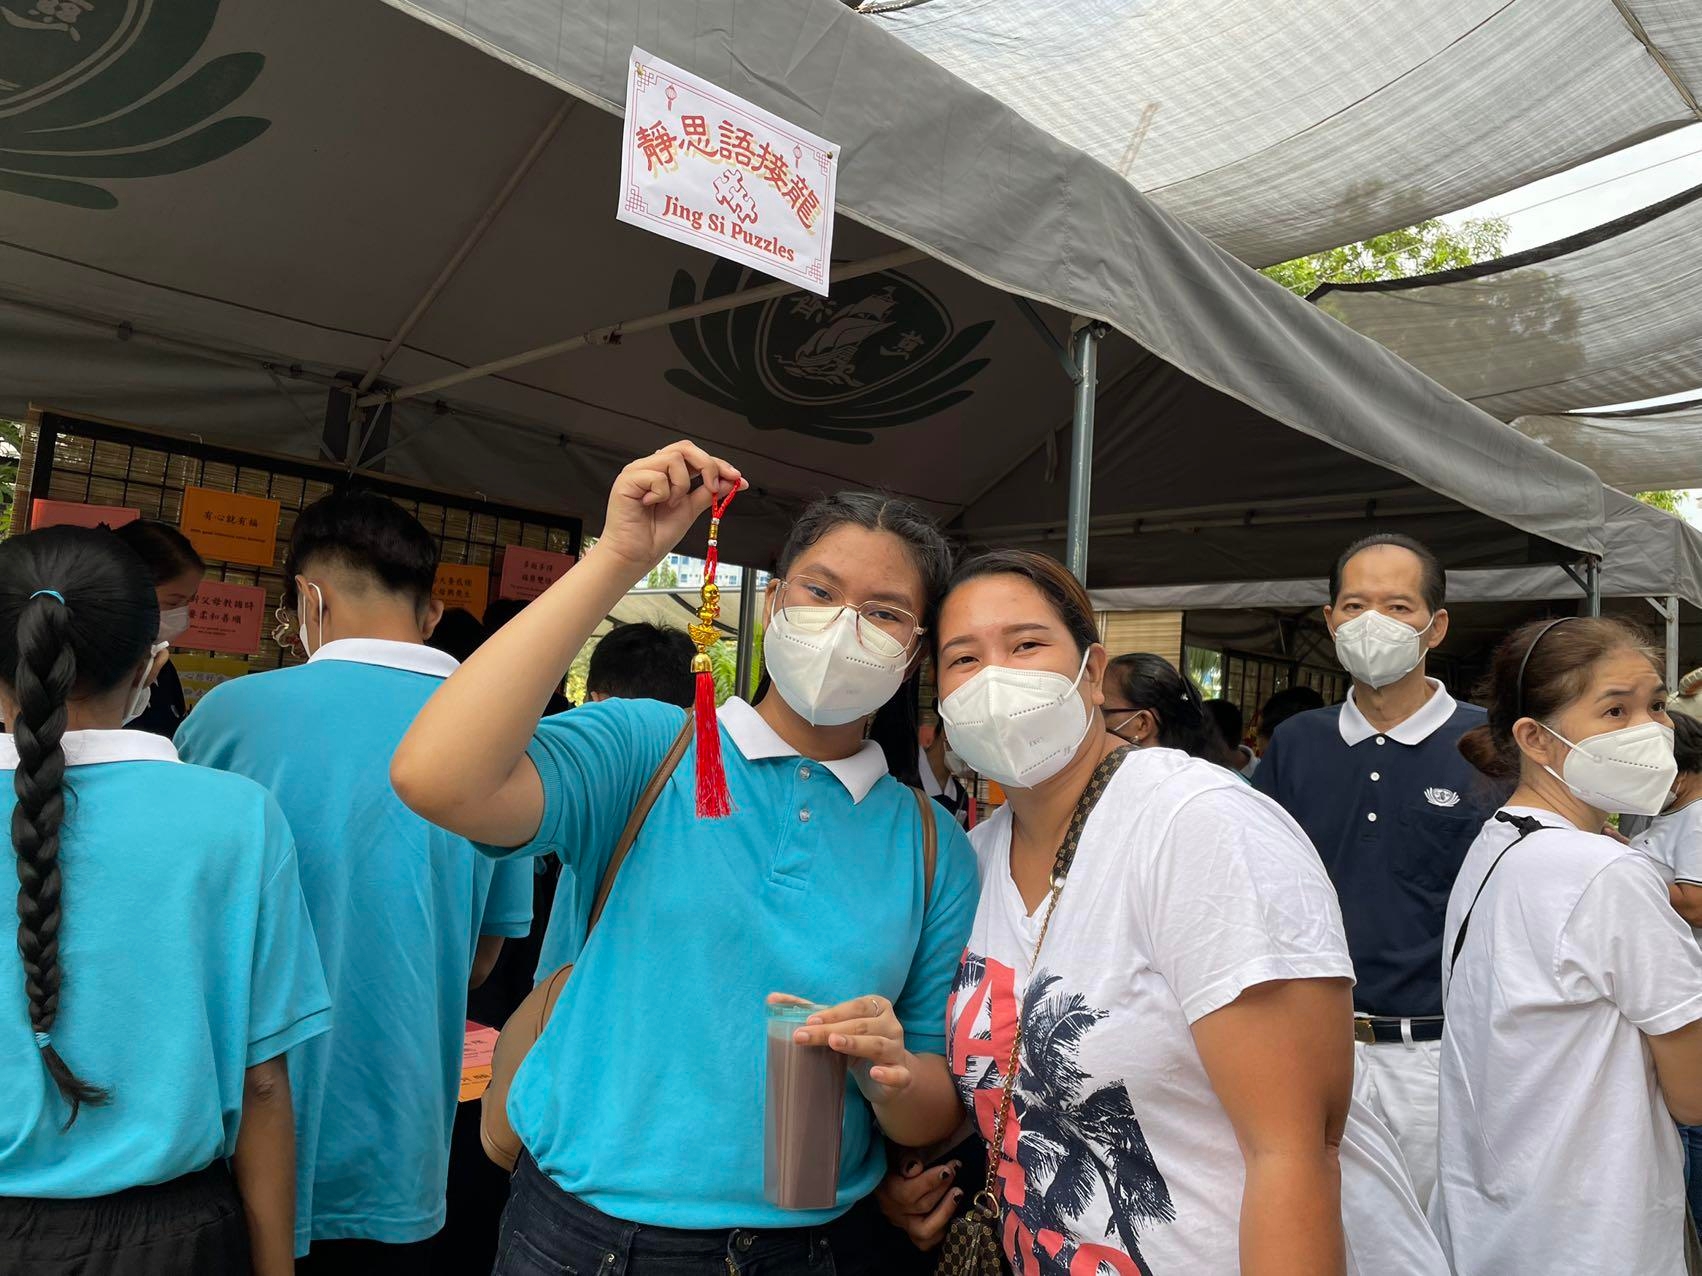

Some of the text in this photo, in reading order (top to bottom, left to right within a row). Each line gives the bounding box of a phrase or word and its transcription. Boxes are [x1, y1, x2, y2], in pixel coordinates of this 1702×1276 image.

[635, 114, 821, 230] 靜思語接龍
[662, 195, 795, 262] Jing Si Puzzles
